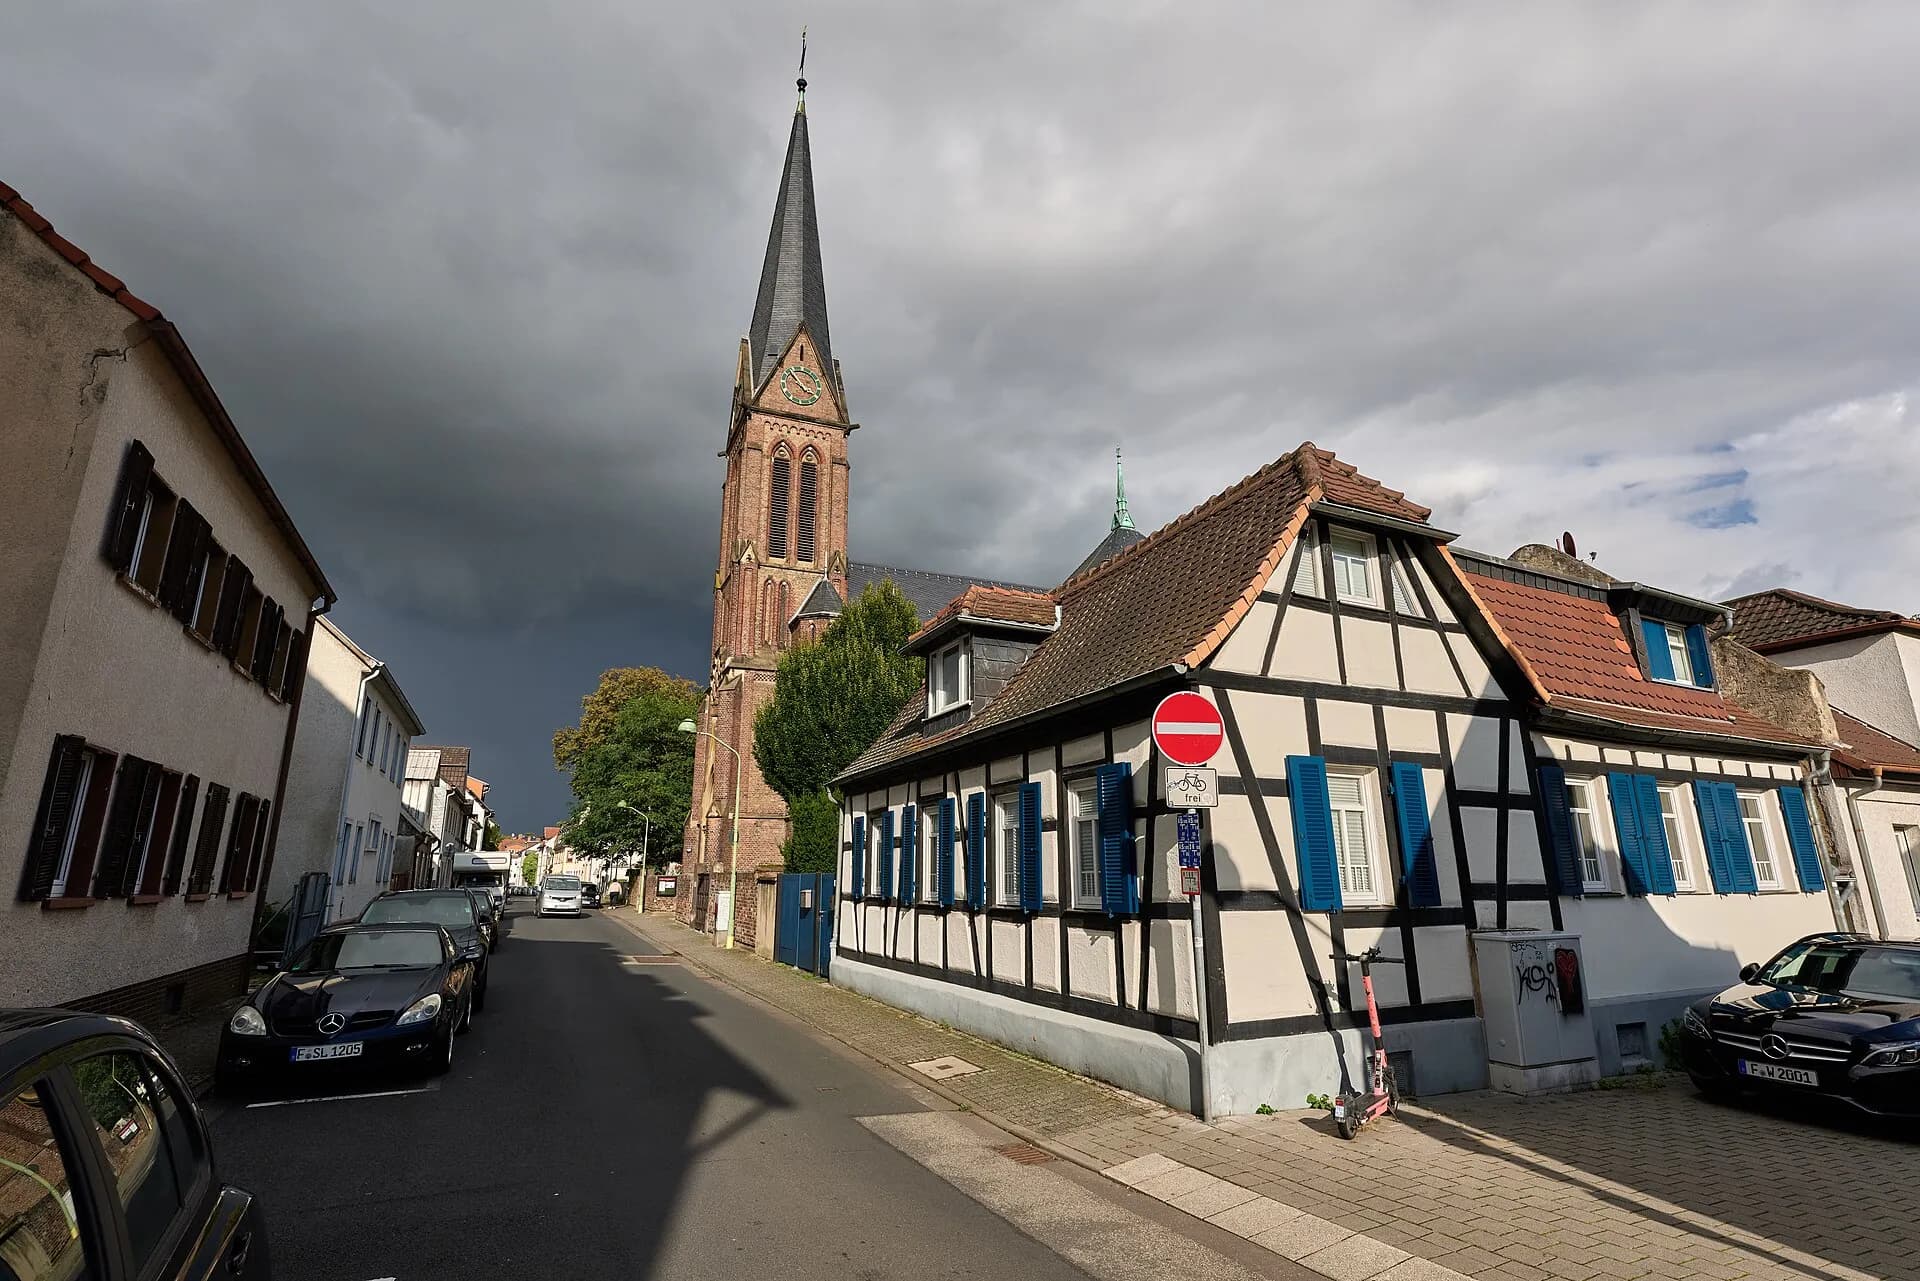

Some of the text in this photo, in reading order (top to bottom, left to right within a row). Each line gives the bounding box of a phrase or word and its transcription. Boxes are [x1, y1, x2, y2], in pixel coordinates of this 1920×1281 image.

[1185, 793, 1201, 803] frei
[297, 1043, 361, 1060] F SL 1205
[1750, 1063, 1759, 1075] F
[1777, 1067, 1812, 1083] 2001
